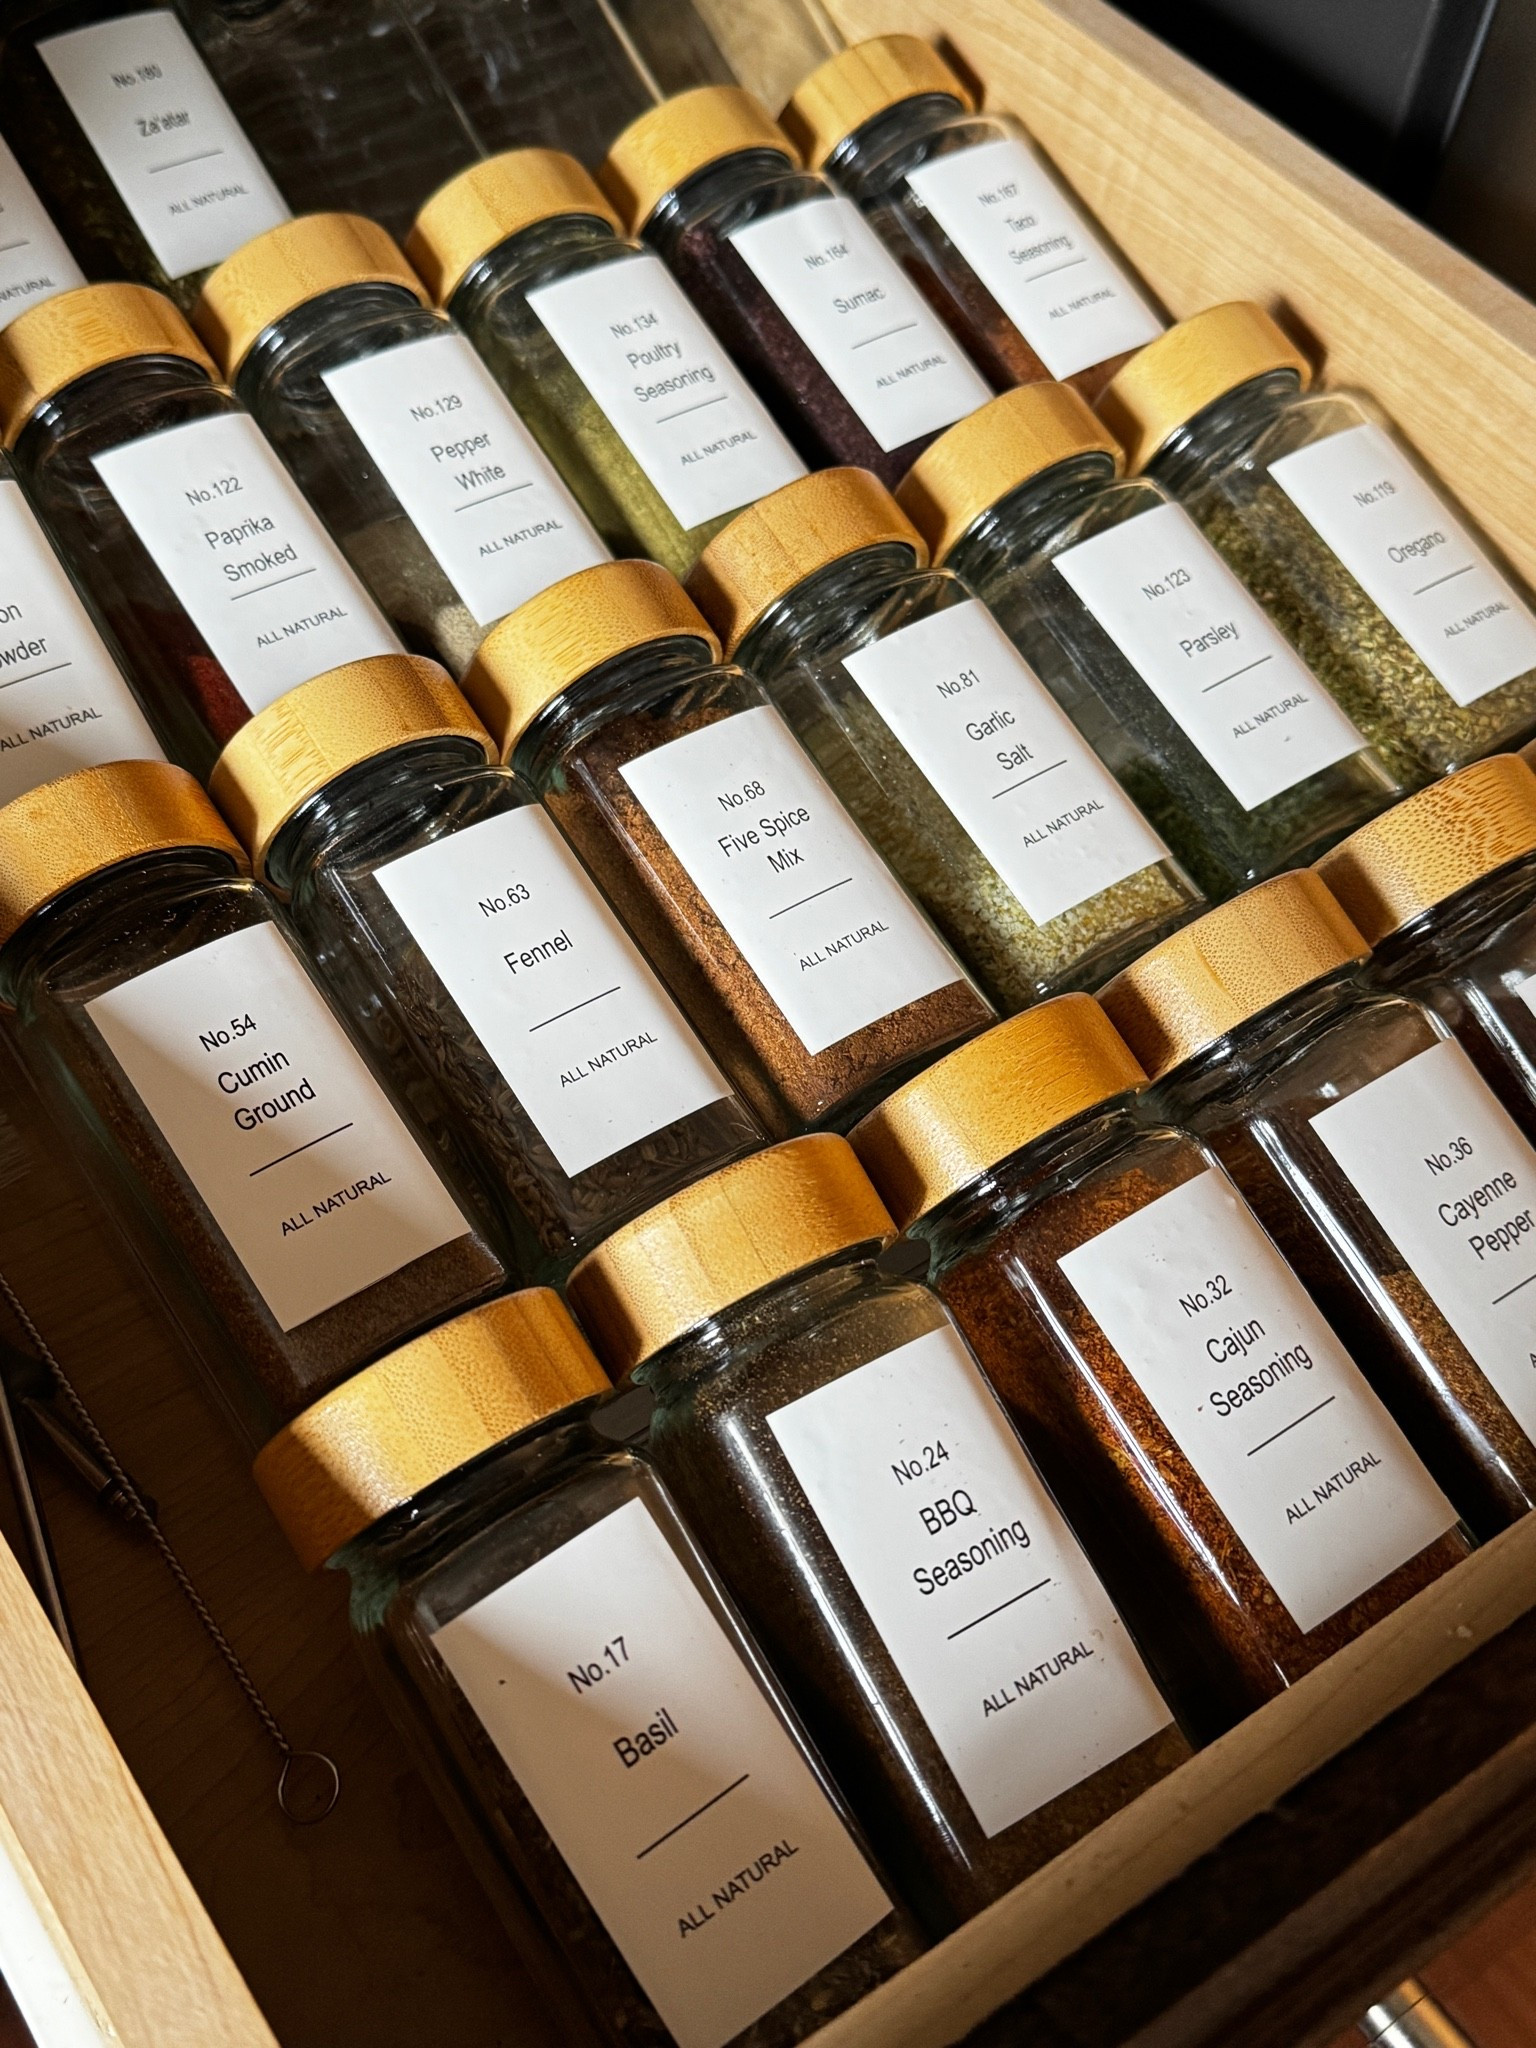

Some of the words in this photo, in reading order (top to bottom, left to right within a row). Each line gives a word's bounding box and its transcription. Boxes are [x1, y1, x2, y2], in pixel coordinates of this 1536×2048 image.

[169, 202, 191, 214] ALL
[191, 185, 248, 207] NATURAL
[1005, 215, 1038, 233] Taco
[1009, 236, 1073, 265] Seasoning
[833, 288, 886, 314] Sumac
[1048, 307, 1070, 319] ALL
[1068, 289, 1115, 312] NATURAL
[610, 313, 658, 339] No.134
[626, 342, 682, 369] Poultry
[876, 375, 898, 388] ALL
[896, 356, 947, 379] NATURAL
[634, 366, 716, 403] Seasoning
[410, 395, 463, 422] No.129
[430, 434, 491, 463] Pepper
[680, 450, 704, 466] ALL
[702, 432, 758, 457] NATURAL
[185, 477, 244, 507] No.122
[454, 466, 506, 491] White
[1352, 481, 1396, 507] No.119
[204, 518, 276, 550] Paprika
[480, 541, 503, 557] ALL
[502, 520, 563, 547] NATURAL
[1387, 531, 1446, 564] Oregano
[223, 544, 298, 582] Smoked
[1141, 568, 1190, 601] No.123
[257, 631, 284, 648] ALL
[281, 607, 348, 637] NATURAL
[1443, 622, 1466, 639] ALL
[1462, 602, 1510, 627] NATURAL
[1179, 622, 1240, 659] Parsley
[936, 668, 981, 699] No.81
[0, 733, 29, 753] ALL
[28, 707, 103, 741] NATURAL
[966, 711, 1016, 741] Garlic
[1232, 721, 1257, 739] ALL
[1254, 694, 1309, 726] NATURAL
[996, 743, 1035, 771] Salt
[718, 780, 766, 812] No.68
[718, 830, 760, 858] Five
[758, 807, 811, 842] Spice
[1023, 829, 1049, 848] ALL
[1046, 799, 1105, 835] NATURAL
[766, 848, 805, 874] Mix
[478, 883, 531, 918] No.63
[504, 928, 574, 975] Fennel
[799, 951, 827, 972] ALL
[824, 920, 890, 958] NATURAL
[199, 1014, 258, 1053] No.54
[218, 1052, 291, 1094] Cumin
[560, 1066, 590, 1089] ALL
[587, 1031, 659, 1072] NATURAL
[237, 1077, 317, 1123] Ground
[1424, 1136, 1474, 1177] No.36
[281, 1212, 314, 1237] ALL
[311, 1171, 393, 1219] NATURAL
[1438, 1171, 1518, 1227] Cayenne
[1468, 1209, 1536, 1261] Pepper
[1179, 1274, 1233, 1319] No.32
[1206, 1319, 1266, 1364] Cajun
[1210, 1344, 1314, 1417] Seasoning
[891, 1439, 950, 1486] No.24
[1285, 1497, 1317, 1526] ALL
[1312, 1451, 1383, 1505] NATURAL
[919, 1489, 978, 1536] BBQ
[913, 1520, 1031, 1596] Seasoning
[566, 1635, 630, 1694] No.17
[982, 1688, 1017, 1718] ALL
[1013, 1641, 1095, 1697] NATURAL
[612, 1706, 680, 1769] Basil
[677, 1904, 716, 1939] ALL
[711, 1839, 800, 1910] NATURAL
